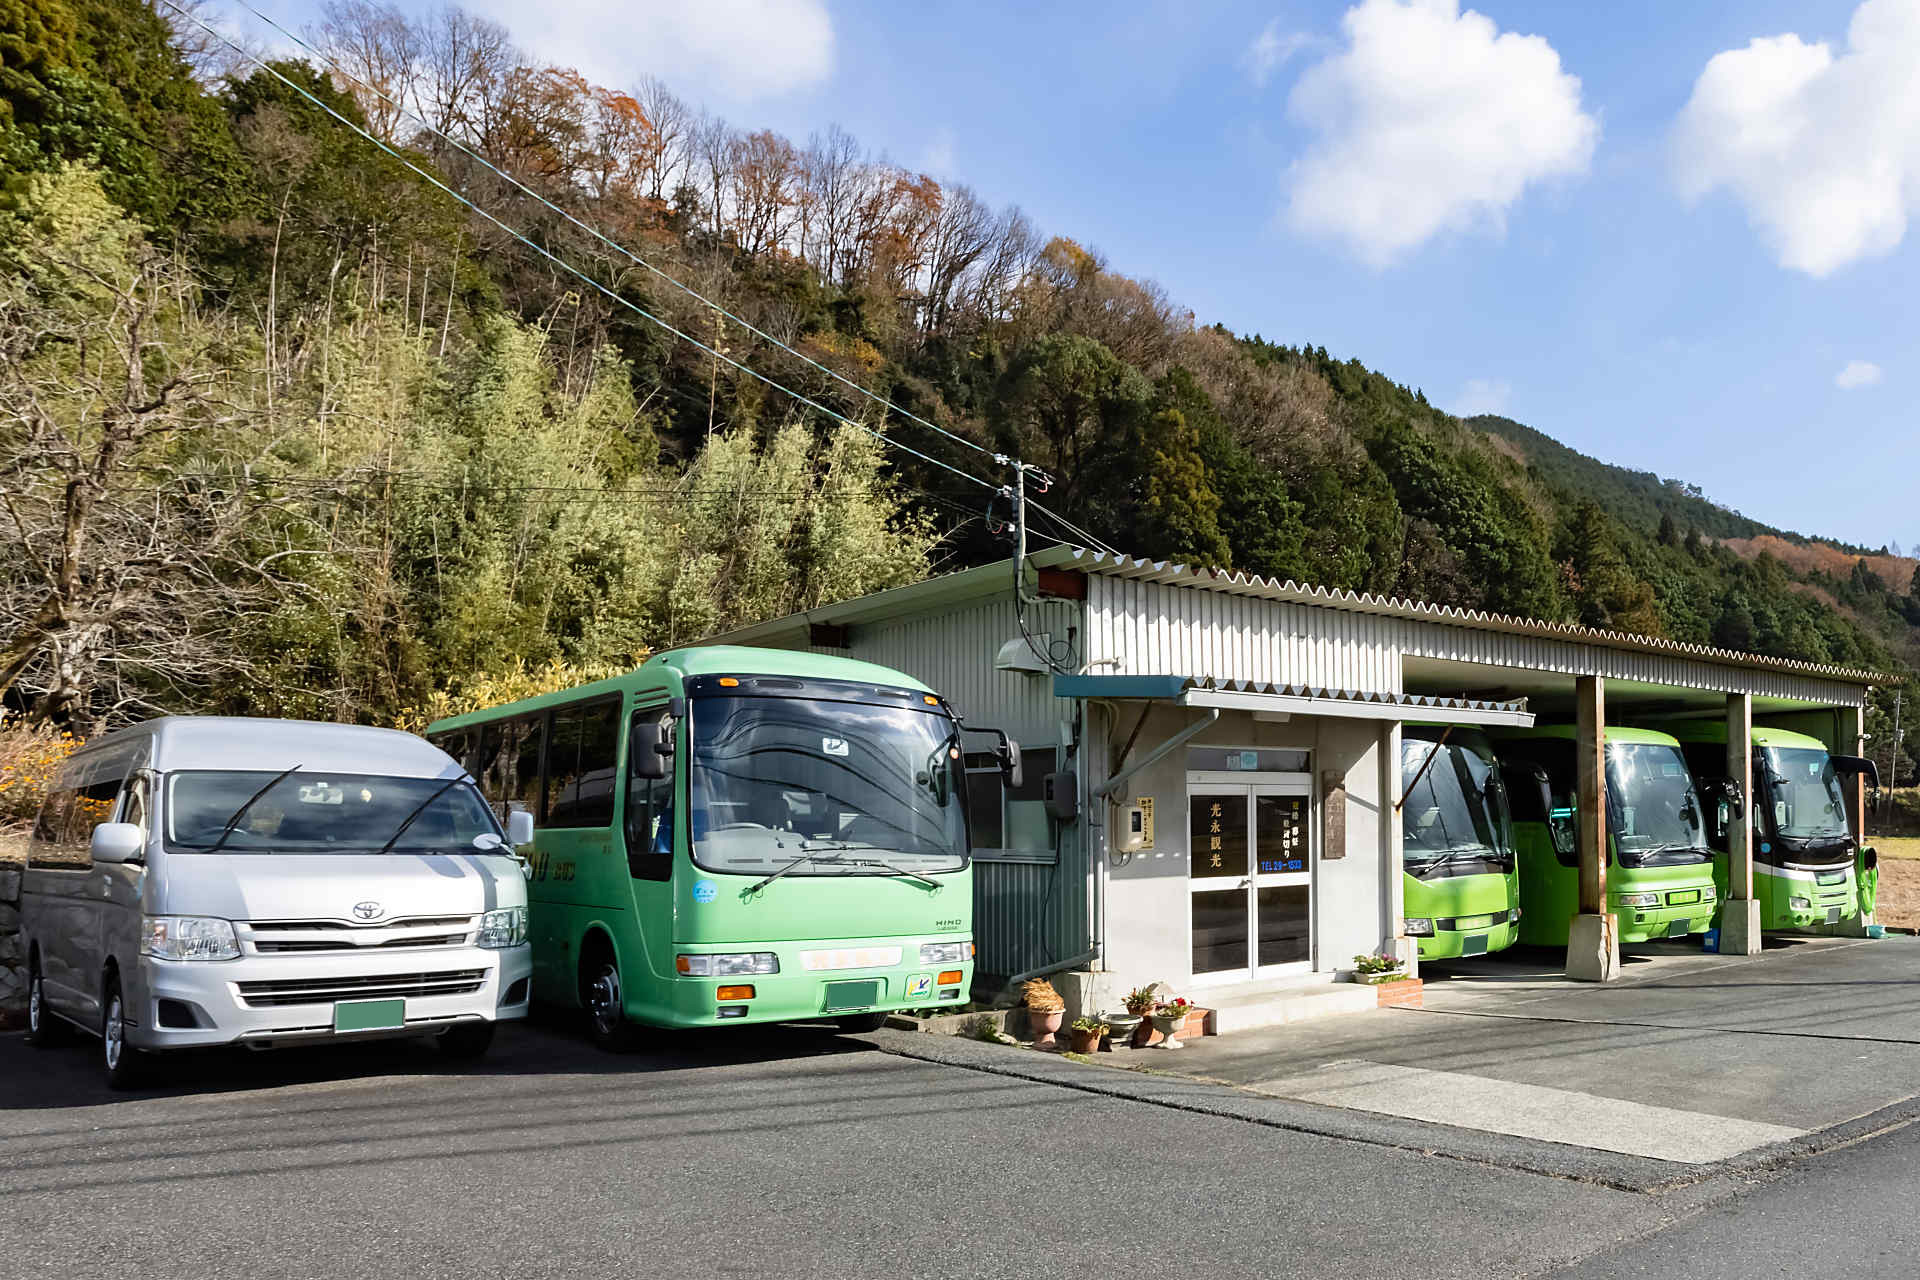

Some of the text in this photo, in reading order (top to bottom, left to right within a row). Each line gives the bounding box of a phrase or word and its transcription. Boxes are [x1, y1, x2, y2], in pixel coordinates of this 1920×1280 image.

[1210, 802, 1222, 868] 光永観光
[1261, 860, 1273, 871] TEL
